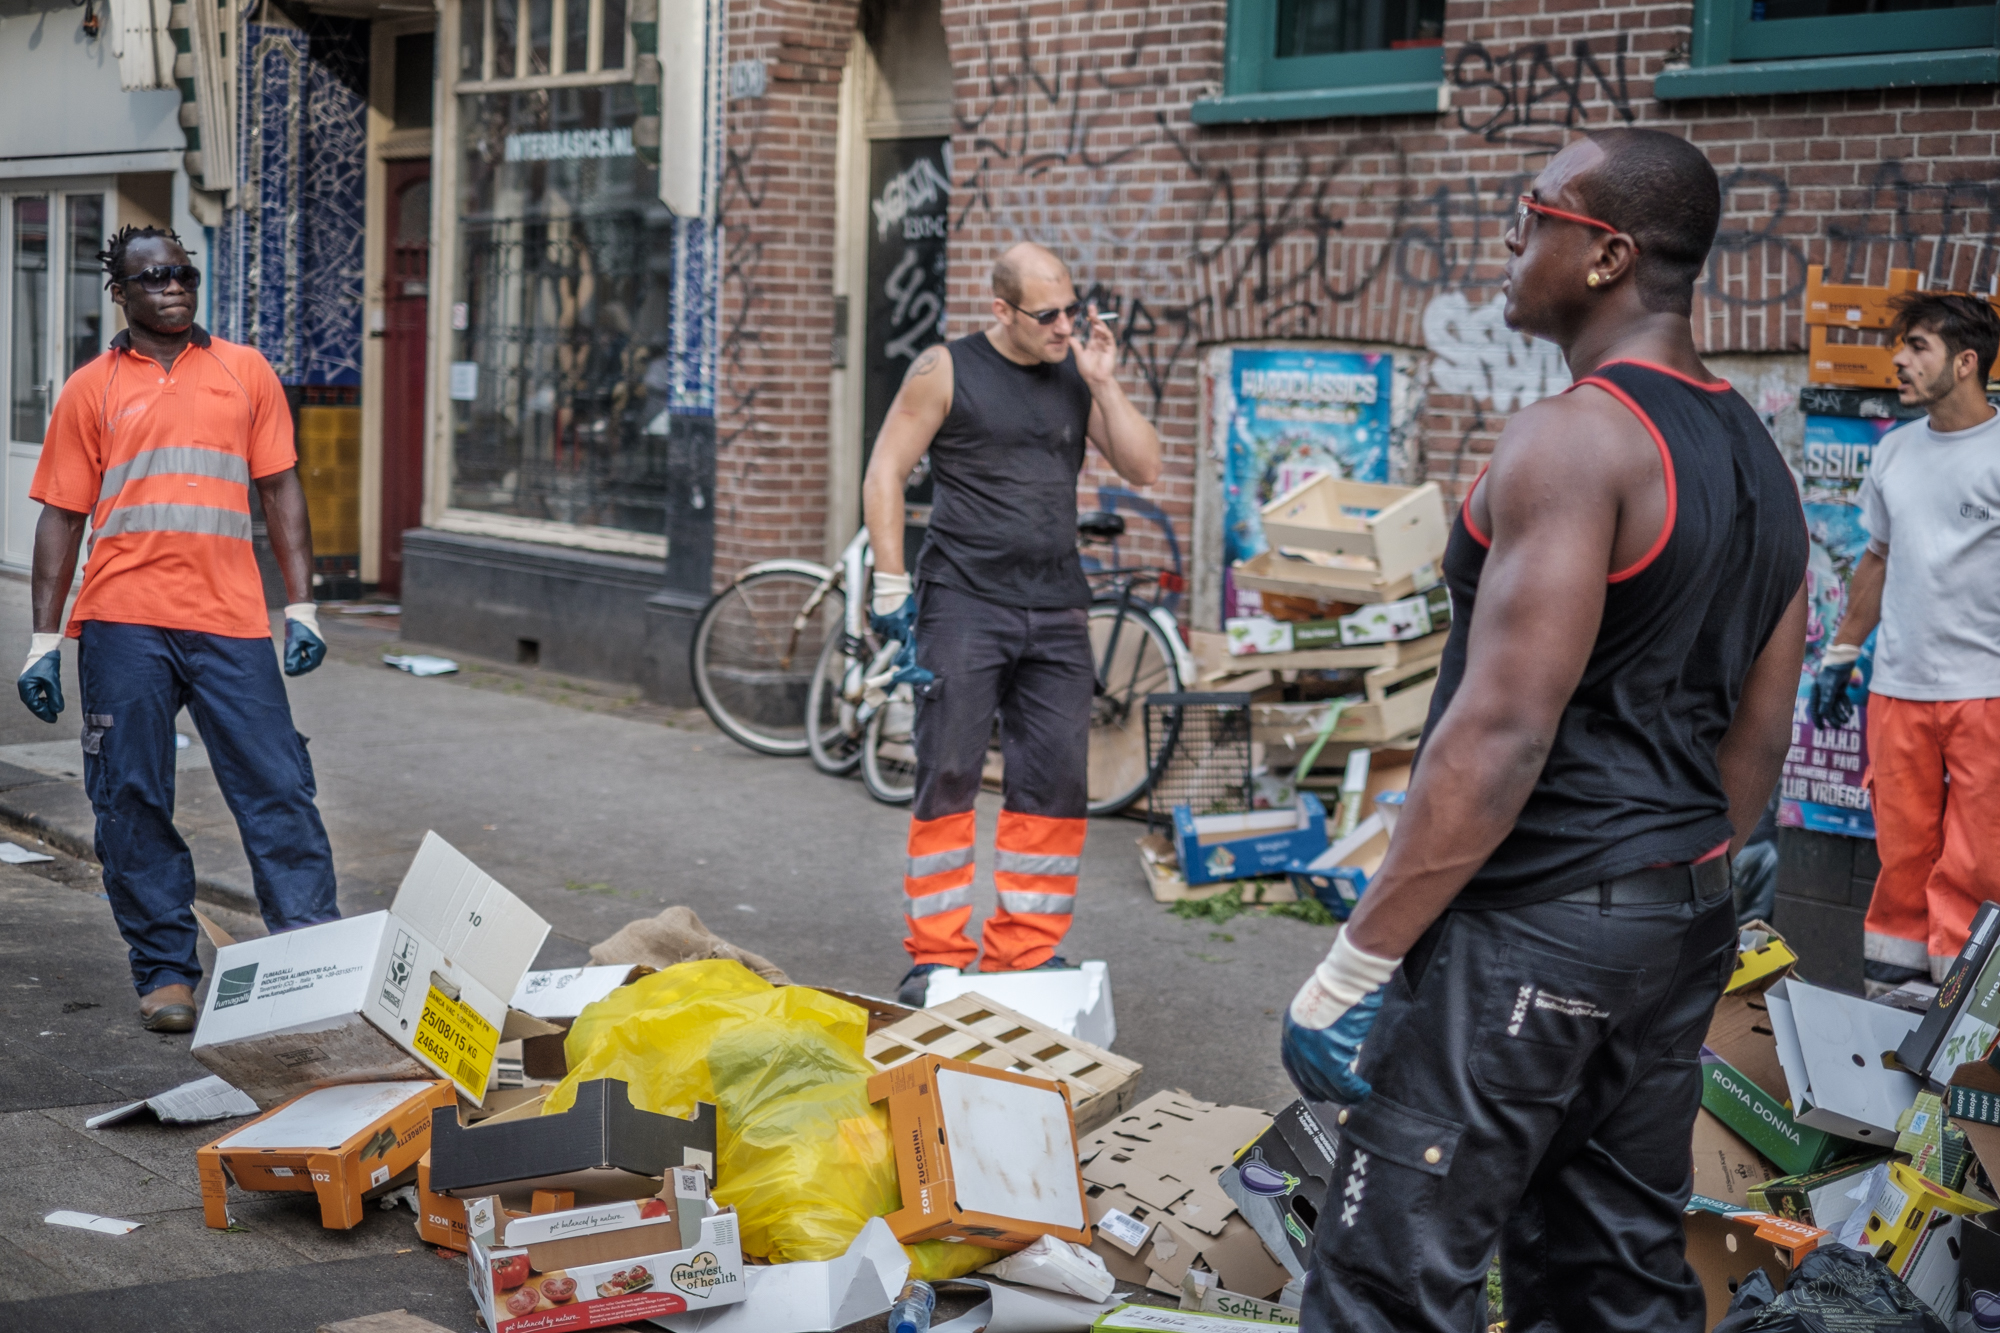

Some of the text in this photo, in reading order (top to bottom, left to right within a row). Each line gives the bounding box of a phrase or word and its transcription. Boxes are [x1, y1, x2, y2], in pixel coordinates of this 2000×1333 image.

[1784, 776, 1808, 800] LUB
[469, 912, 482, 927] 10
[261, 975, 289, 986] INDUSTRIA
[290, 967, 322, 981] ALIMENTARI
[262, 968, 293, 980] FUMAGALLI
[215, 993, 250, 1009] fumagalli
[422, 1007, 466, 1051] 25/08/15
[418, 1032, 449, 1064] 246433
[467, 1044, 477, 1059] KG
[1712, 1069, 1800, 1145] ROMA DONNA
[397, 1120, 431, 1148] COURGETTE
[912, 1129, 926, 1186] ZUCCHINI
[920, 1189, 931, 1215] ZON
[429, 1214, 449, 1226] ZON
[1752, 1214, 1818, 1238] katopé
[676, 1265, 722, 1282] Harvest
[686, 1272, 737, 1290] of health
[1217, 1297, 1263, 1318] Soft
